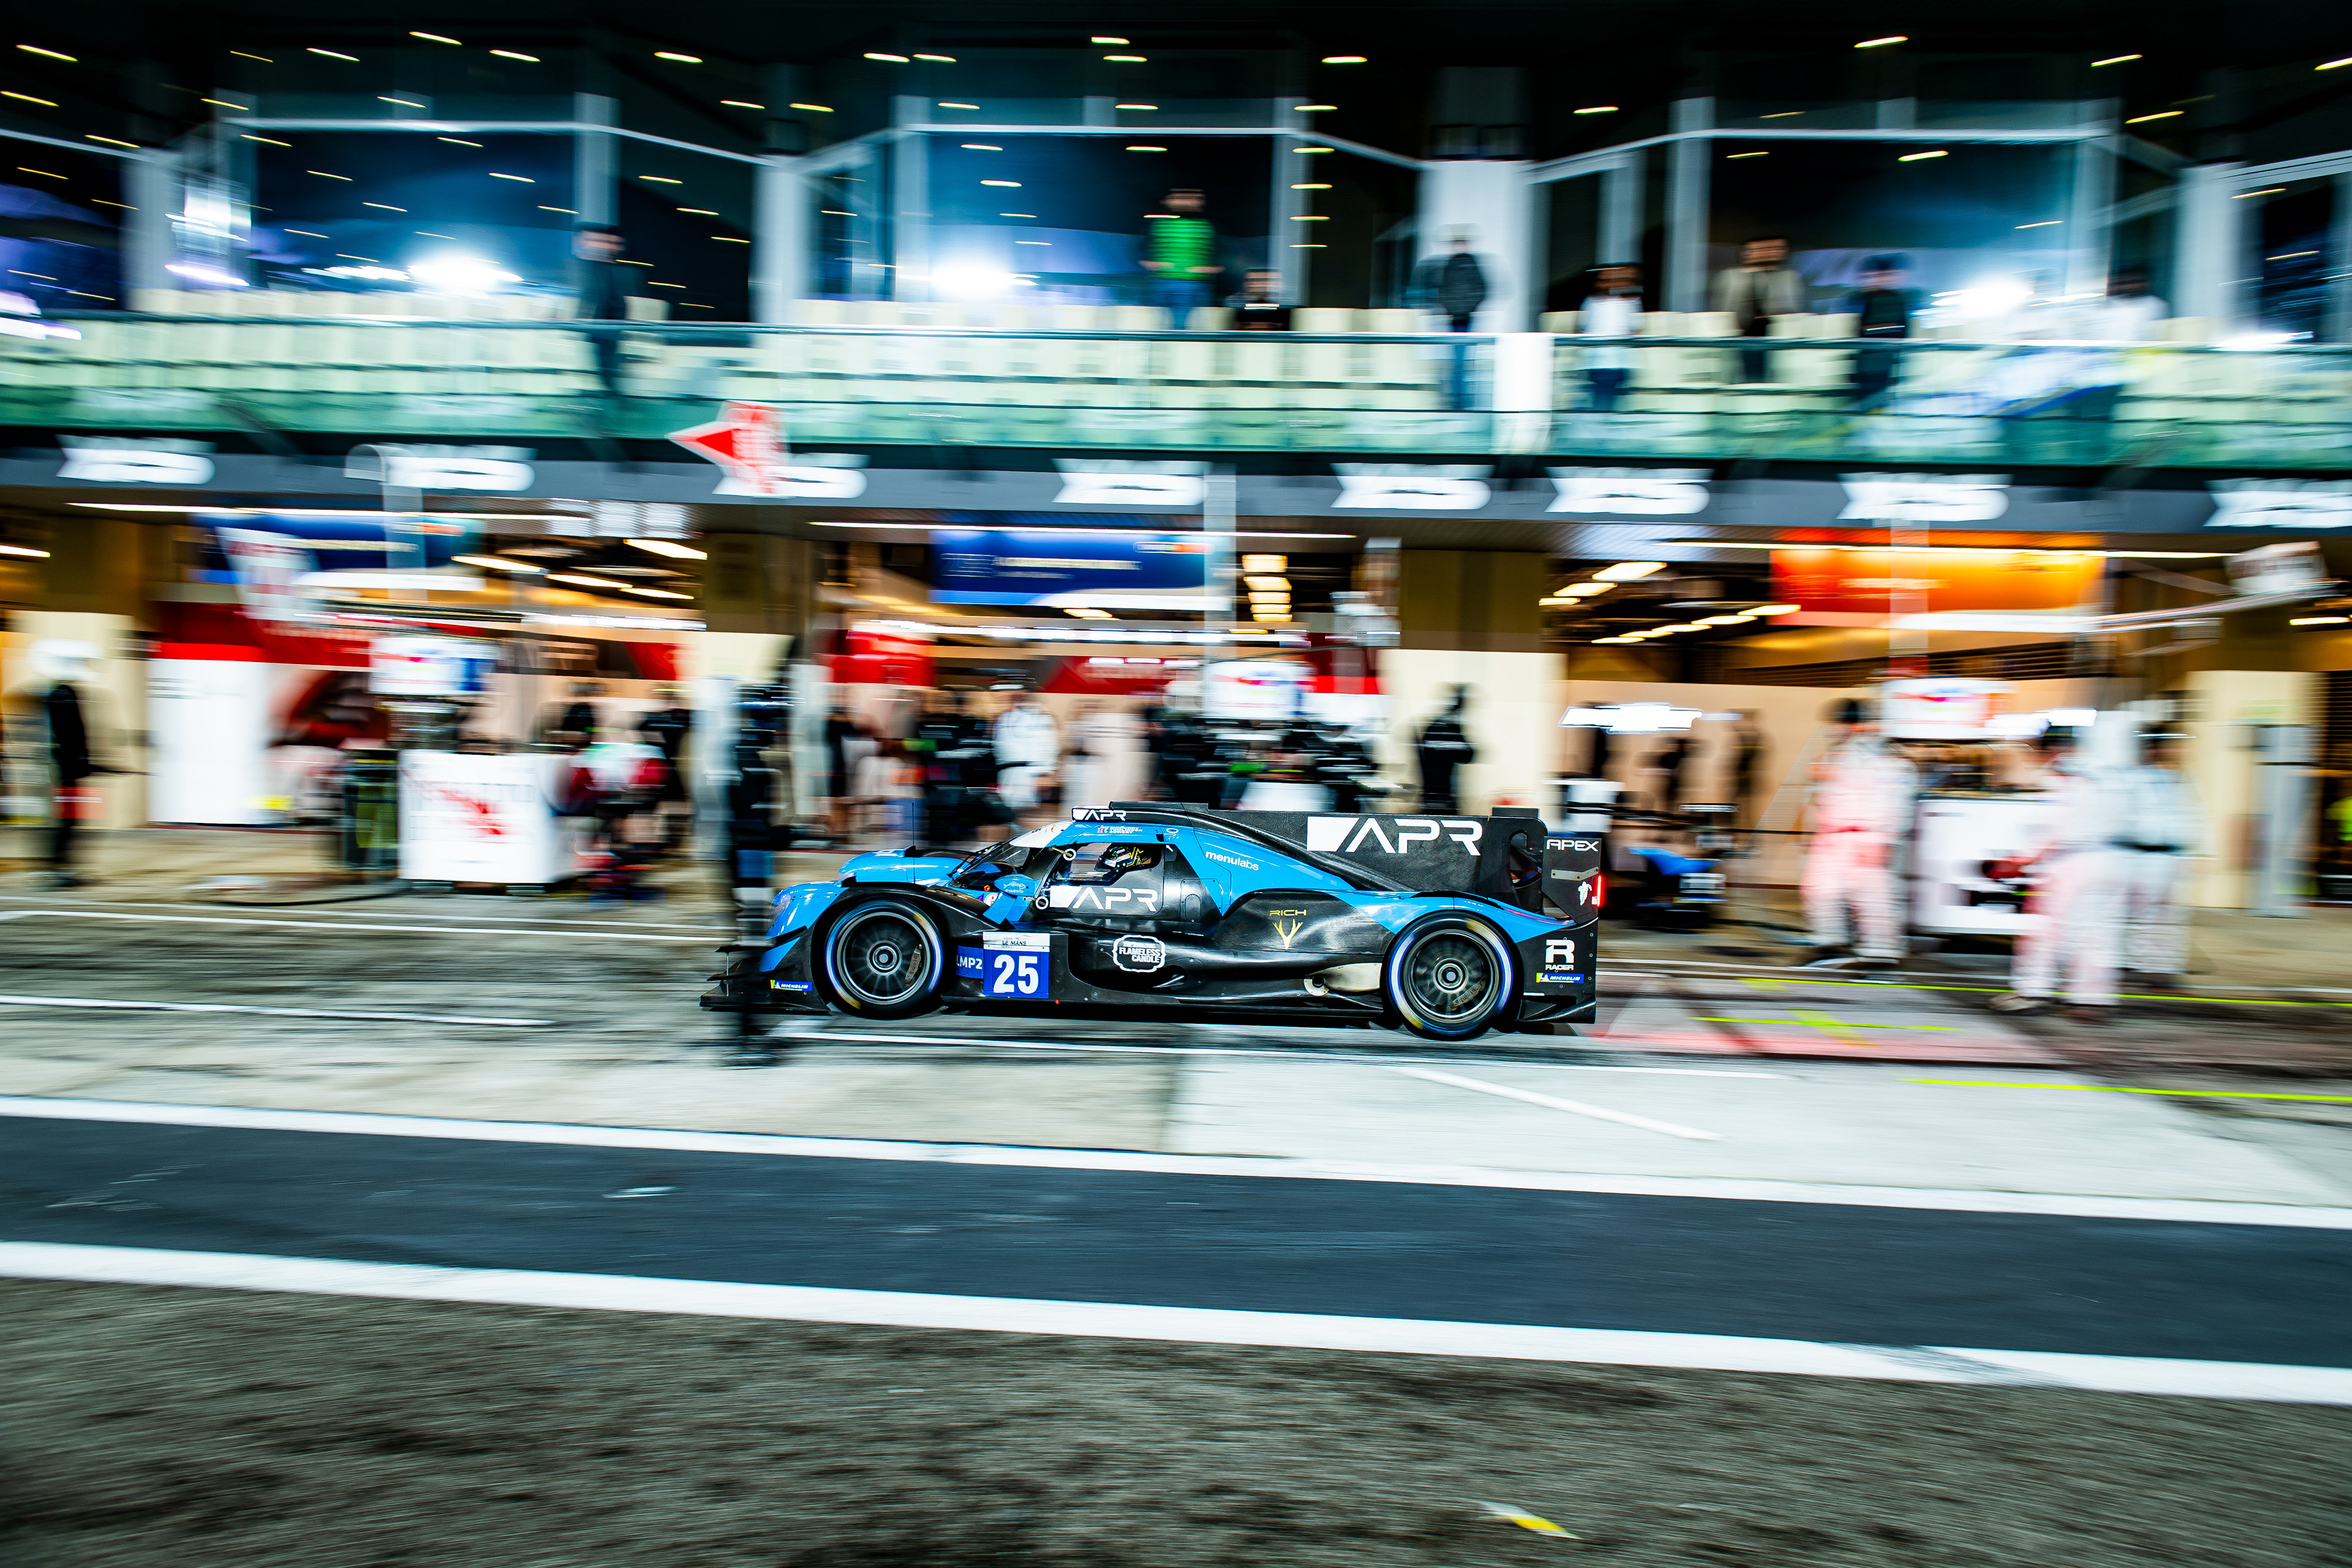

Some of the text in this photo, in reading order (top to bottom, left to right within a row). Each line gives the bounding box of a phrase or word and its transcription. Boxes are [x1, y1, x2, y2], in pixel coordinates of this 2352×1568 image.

[1084, 809, 1127, 821] APR
[1344, 818, 1483, 856] APR
[1546, 839, 1599, 852] APEX
[1205, 851, 1259, 871] menulabs
[1072, 887, 1158, 912] APR
[1118, 947, 1161, 956] FLAMELESS
[1131, 954, 1161, 963] CANDLE
[956, 955, 982, 970] LMP2
[993, 954, 1039, 994] 25
